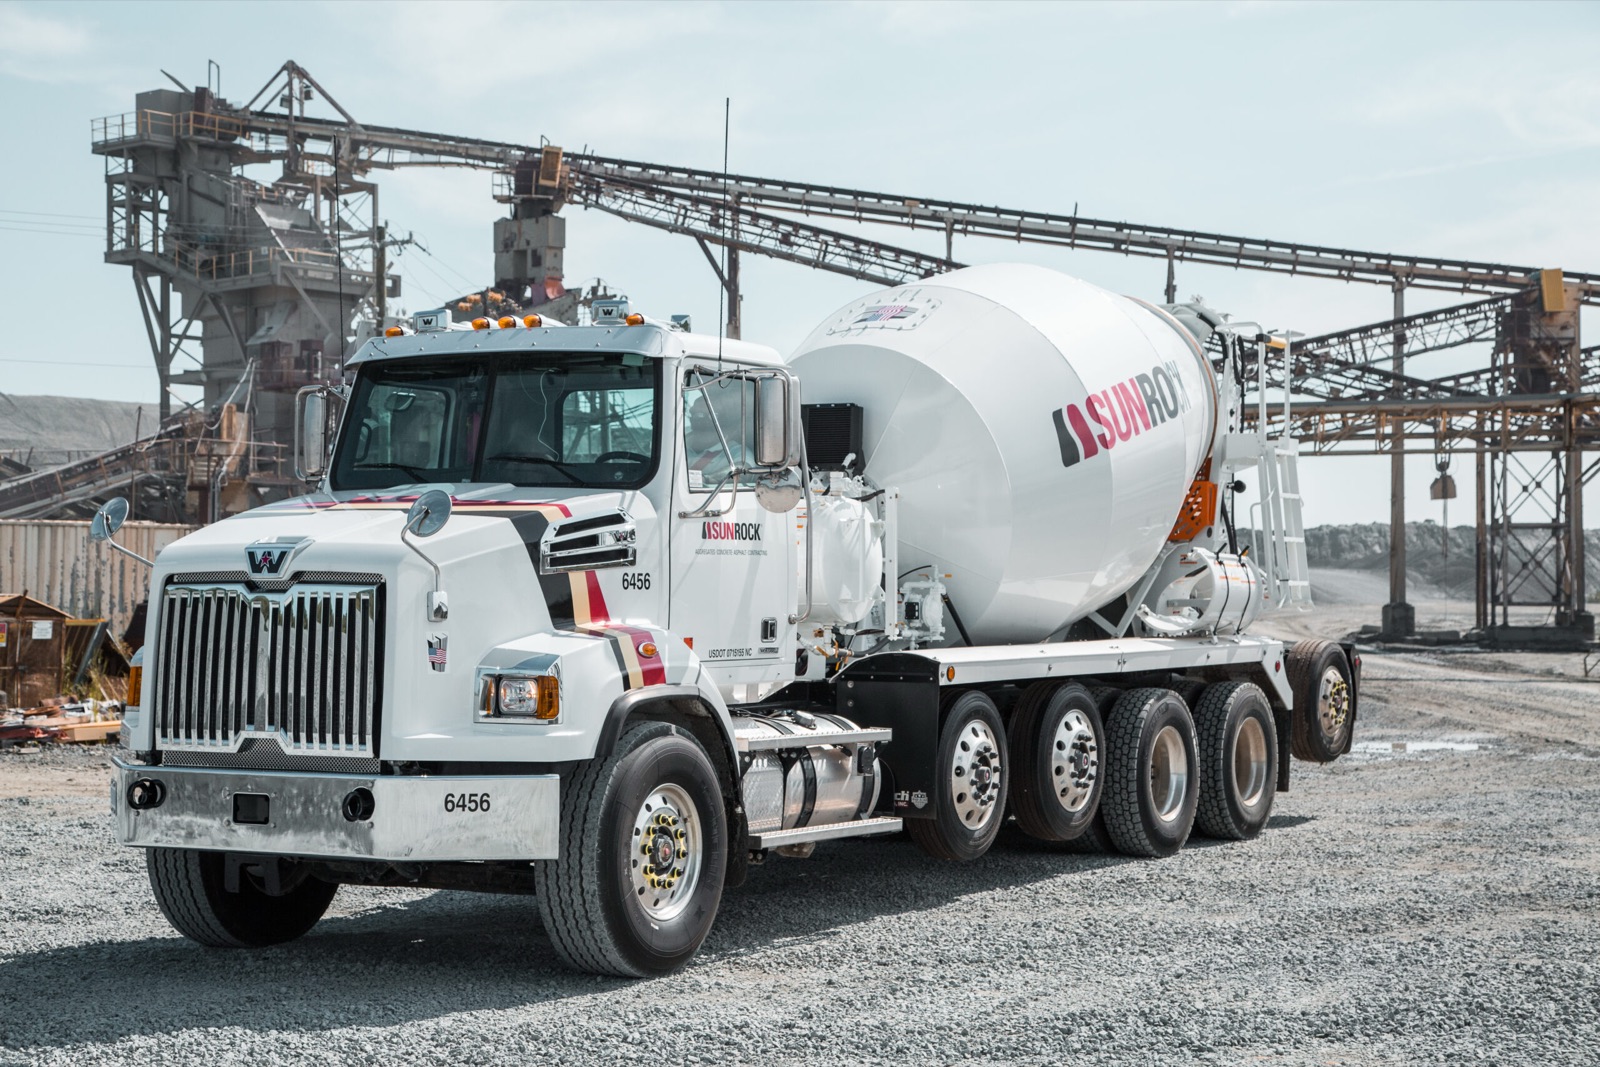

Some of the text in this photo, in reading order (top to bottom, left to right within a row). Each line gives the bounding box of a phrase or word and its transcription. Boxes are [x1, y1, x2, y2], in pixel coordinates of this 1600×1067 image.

[1085, 360, 1191, 450] SUNROCK
[712, 521, 761, 541] SUNROCK
[622, 572, 651, 591] 6456
[708, 649, 726, 659] USDOT
[745, 647, 753, 657] NC
[444, 792, 491, 813] 6456
